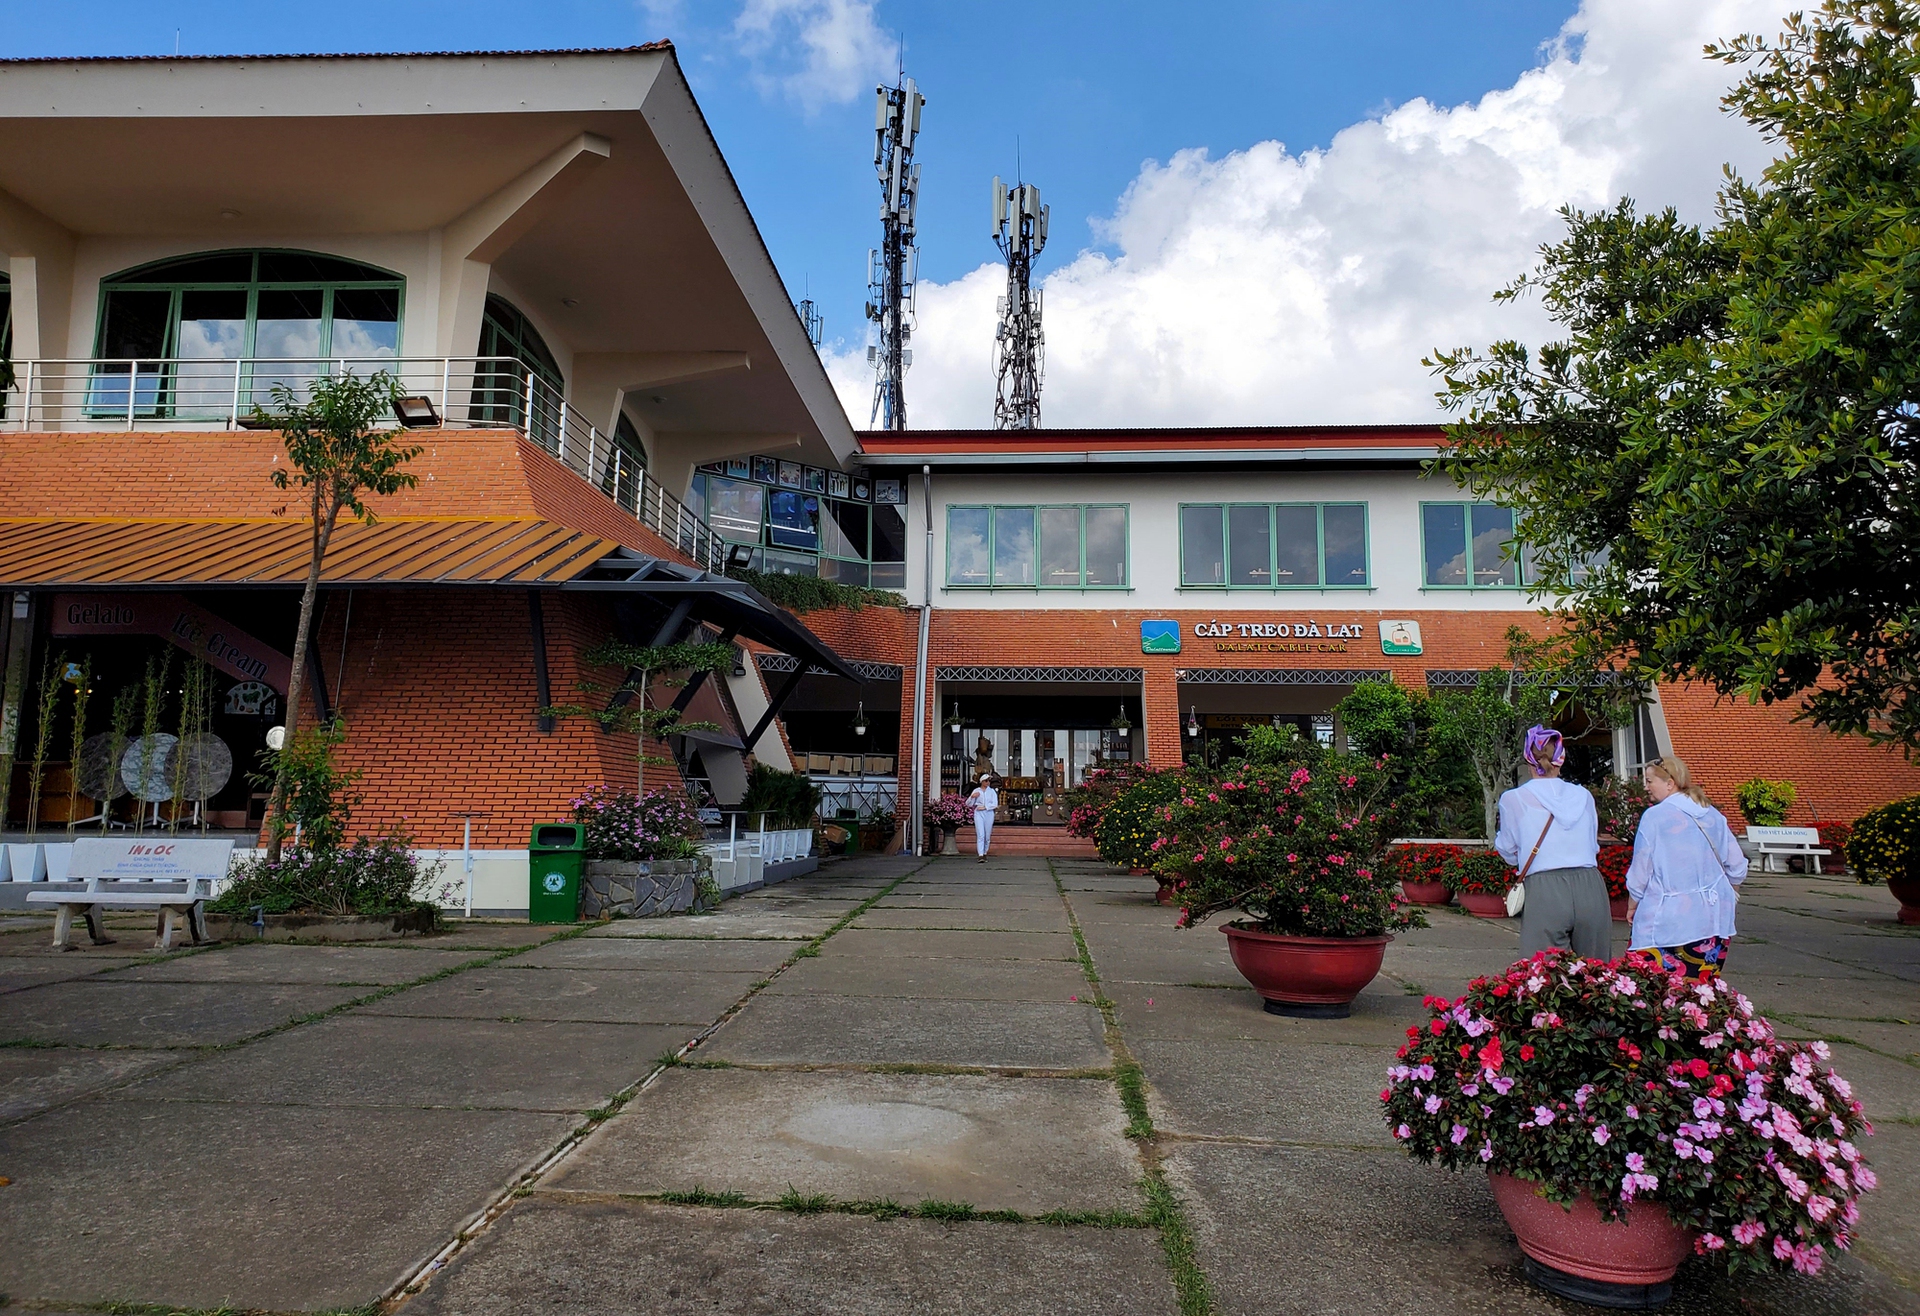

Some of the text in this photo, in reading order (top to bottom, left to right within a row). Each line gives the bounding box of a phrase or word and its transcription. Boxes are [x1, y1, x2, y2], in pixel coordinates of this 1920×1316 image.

[67, 603, 135, 625] Gelato
[1194, 619, 1363, 643] CÁP TREO ĐÀ LẠT
[171, 612, 269, 680] Ice Cream
[1216, 642, 1347, 652] DALAT CABLE CAR
